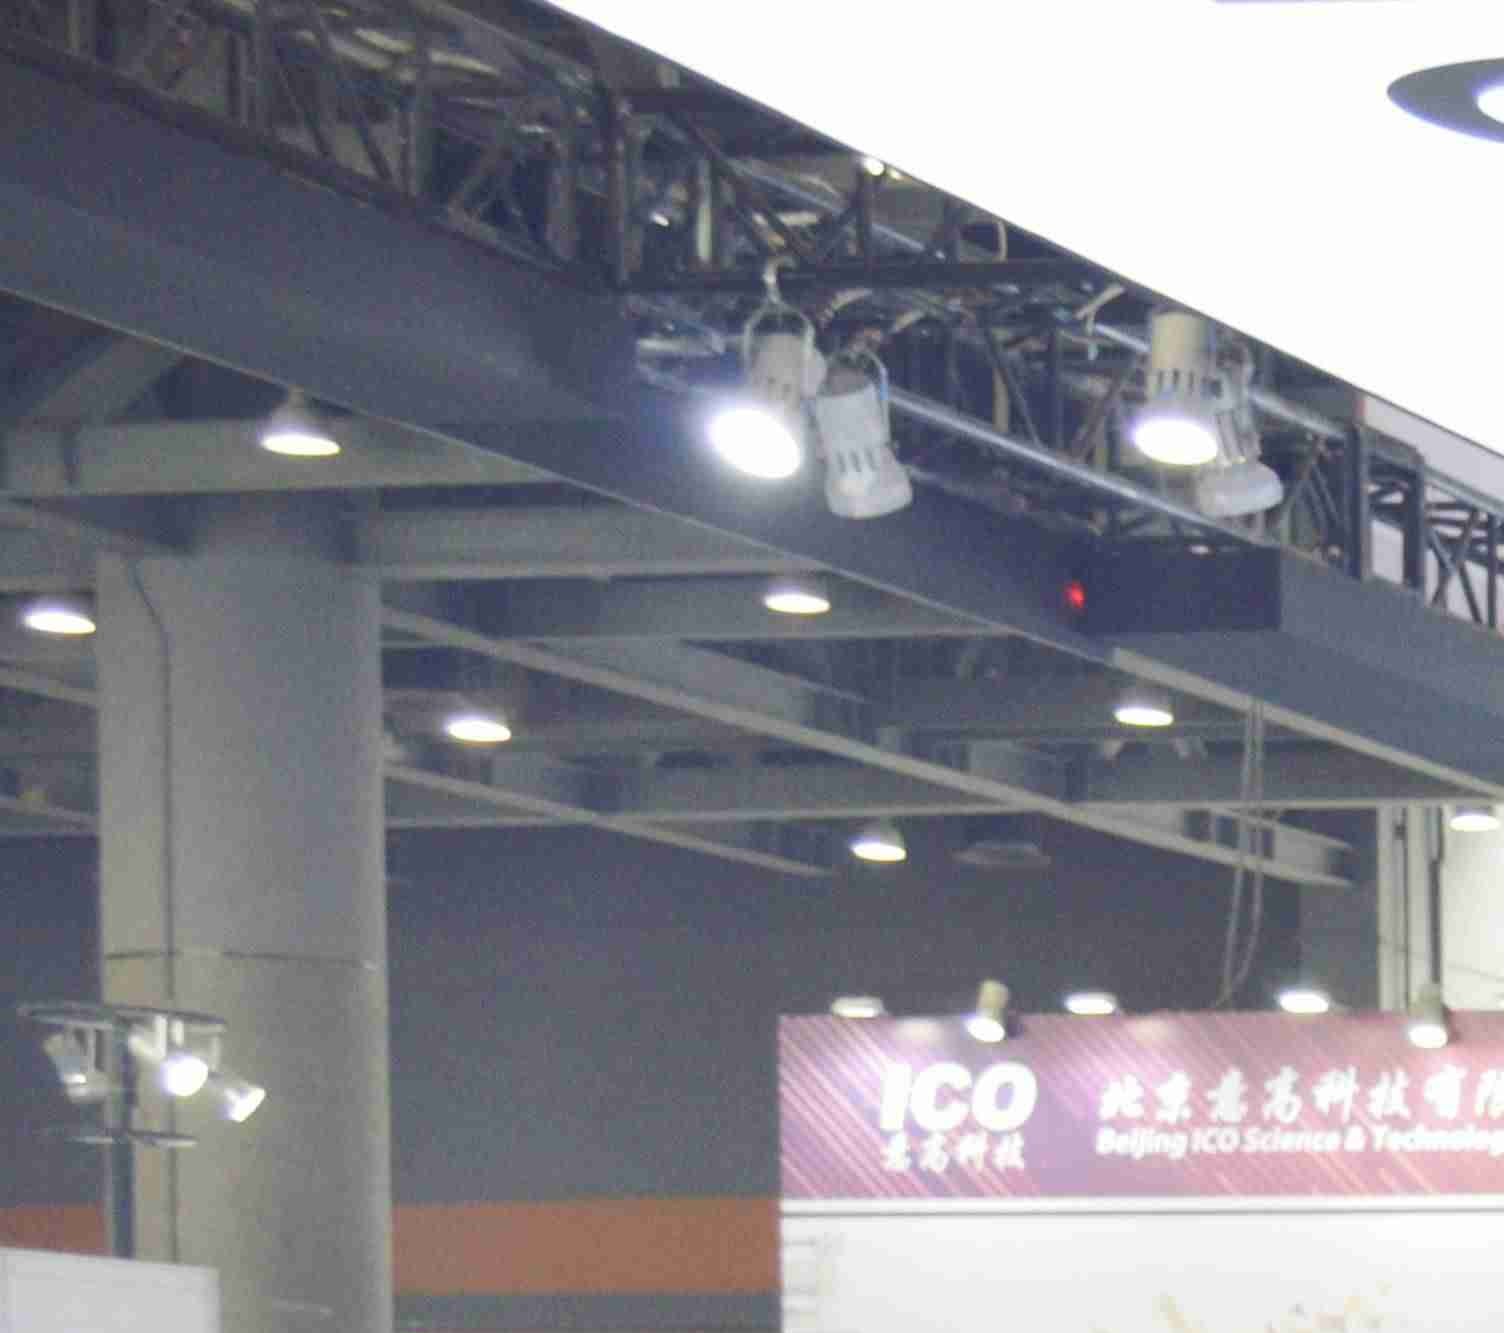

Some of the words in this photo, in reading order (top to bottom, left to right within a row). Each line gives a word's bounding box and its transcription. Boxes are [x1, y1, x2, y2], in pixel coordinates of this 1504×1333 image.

[879, 1060, 1038, 1133] ICO
[1097, 1125, 1189, 1160] Beijing
[1193, 1126, 1241, 1152] ICO
[1245, 1126, 1341, 1152] Science
